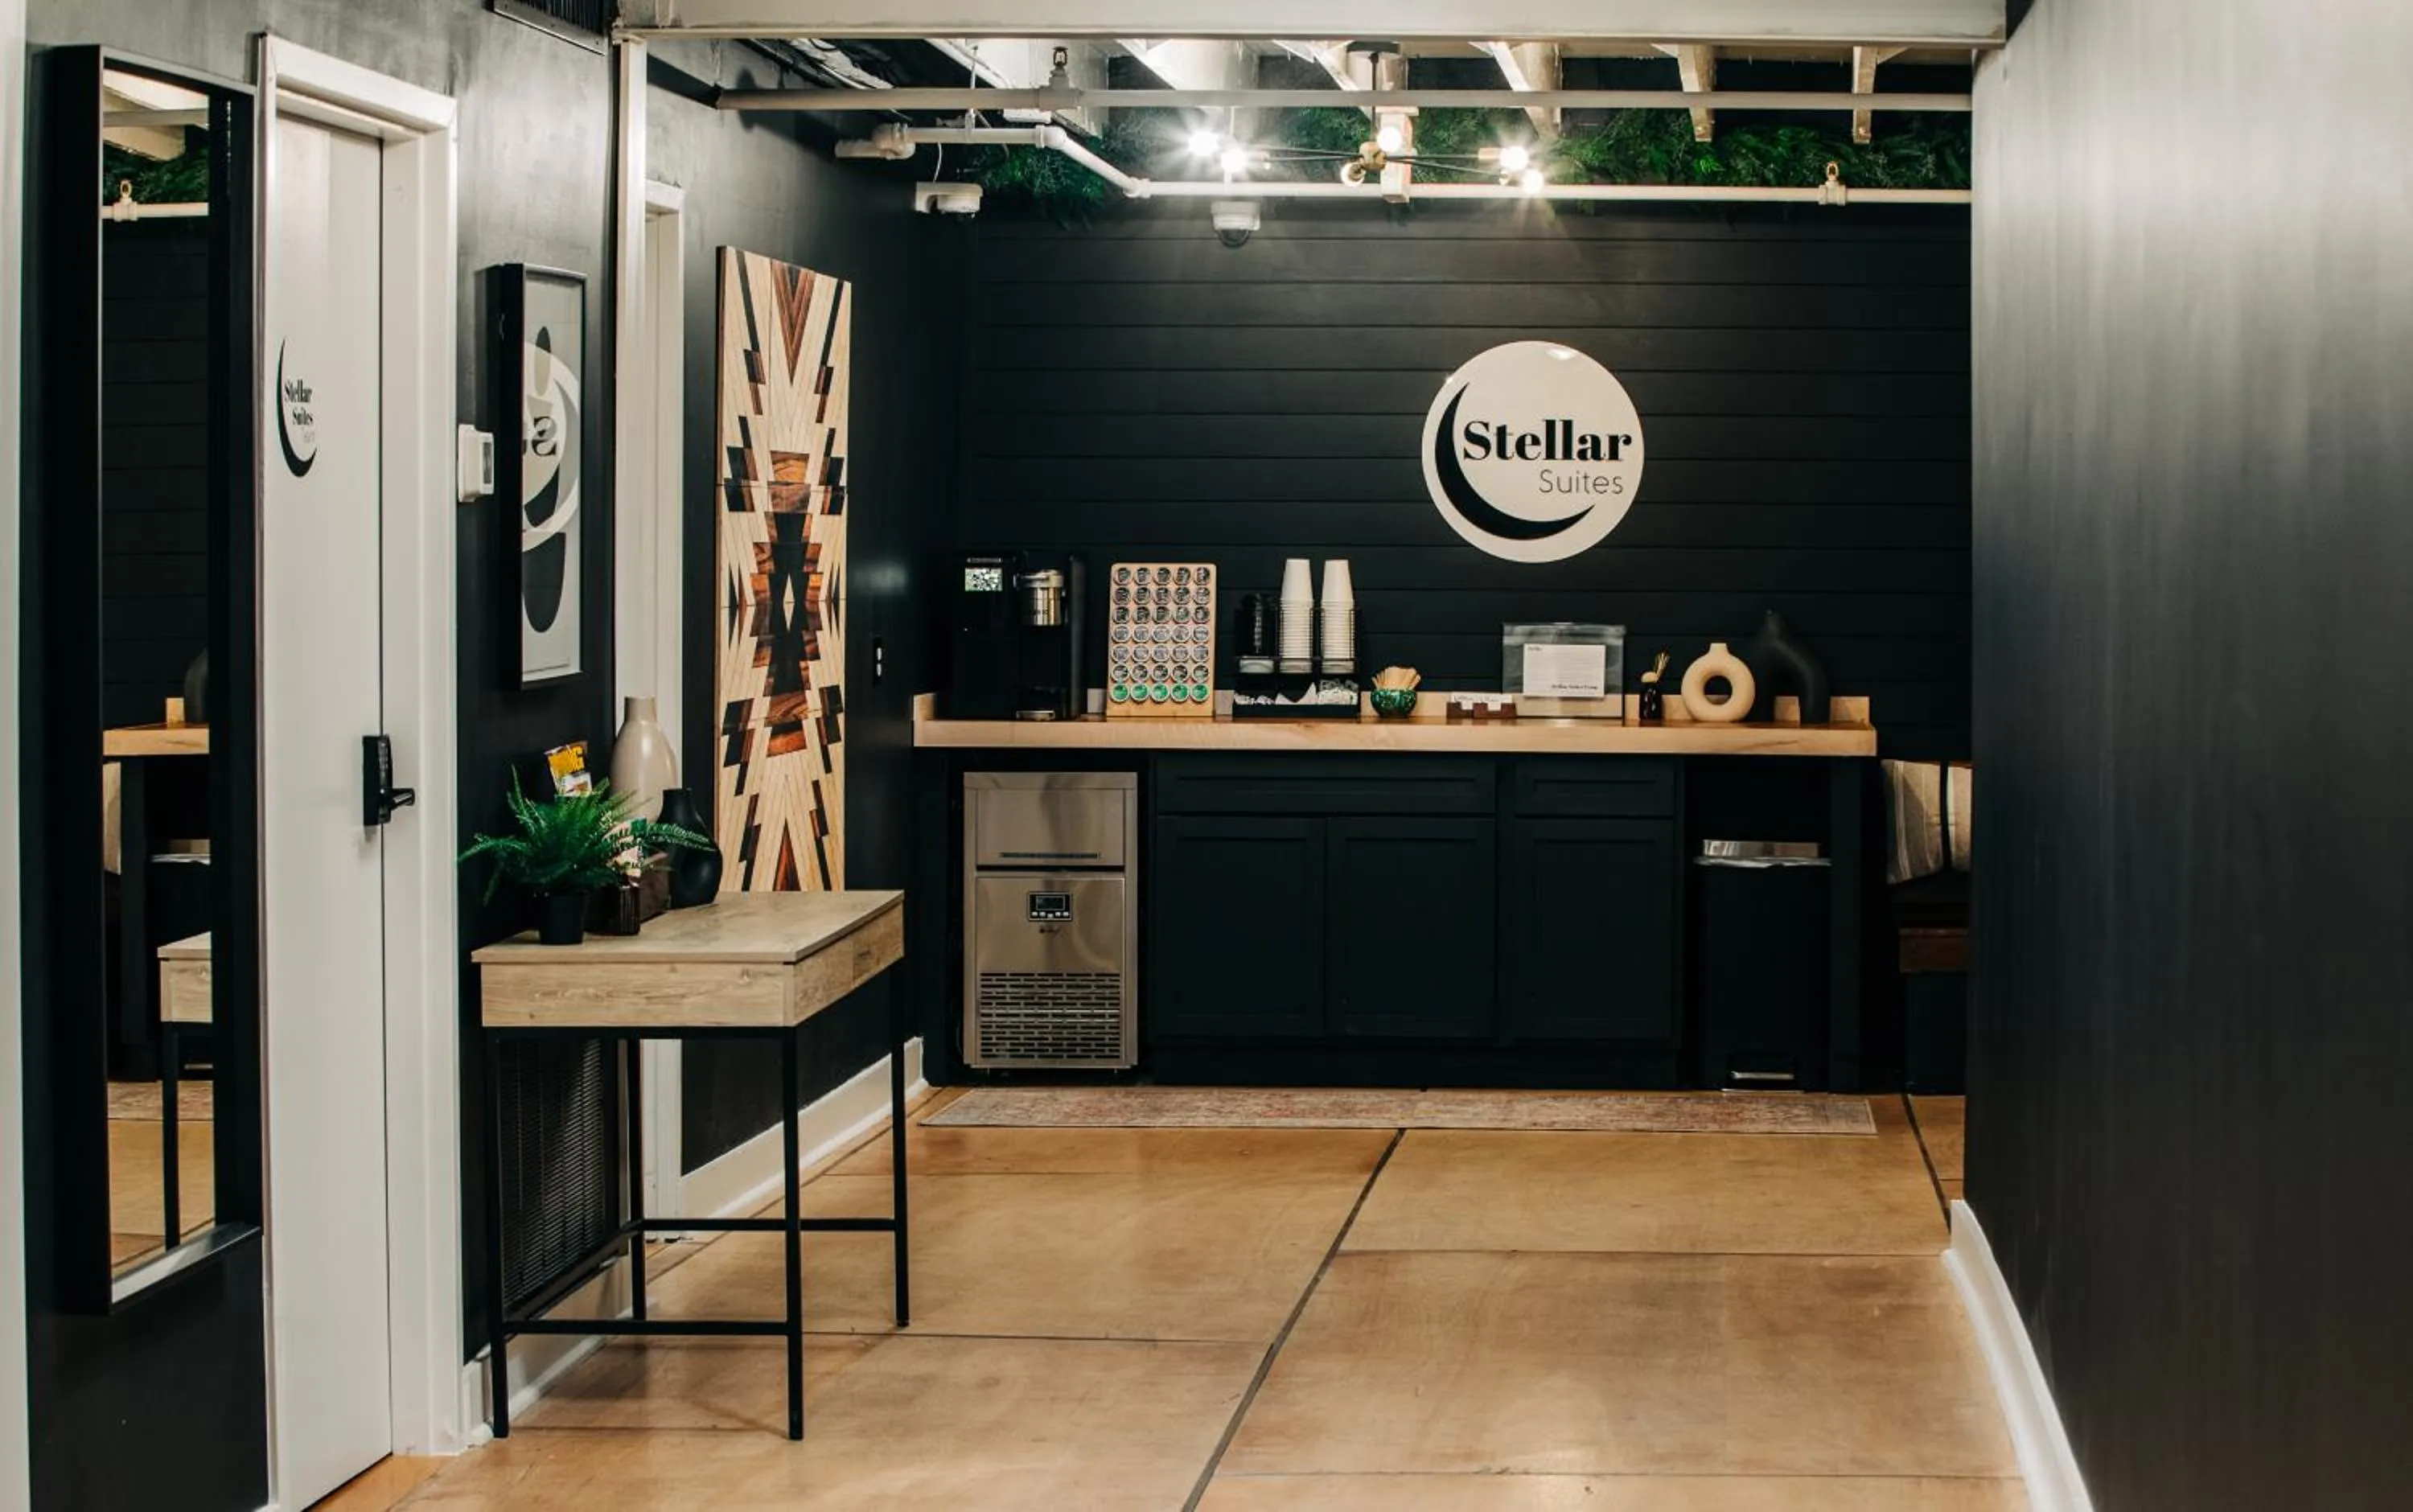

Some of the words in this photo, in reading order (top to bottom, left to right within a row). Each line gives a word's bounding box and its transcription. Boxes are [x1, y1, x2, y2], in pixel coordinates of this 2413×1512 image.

[284, 379, 313, 403] Stellar
[1463, 419, 1632, 462] Stellar
[1539, 469, 1624, 495] Suites
